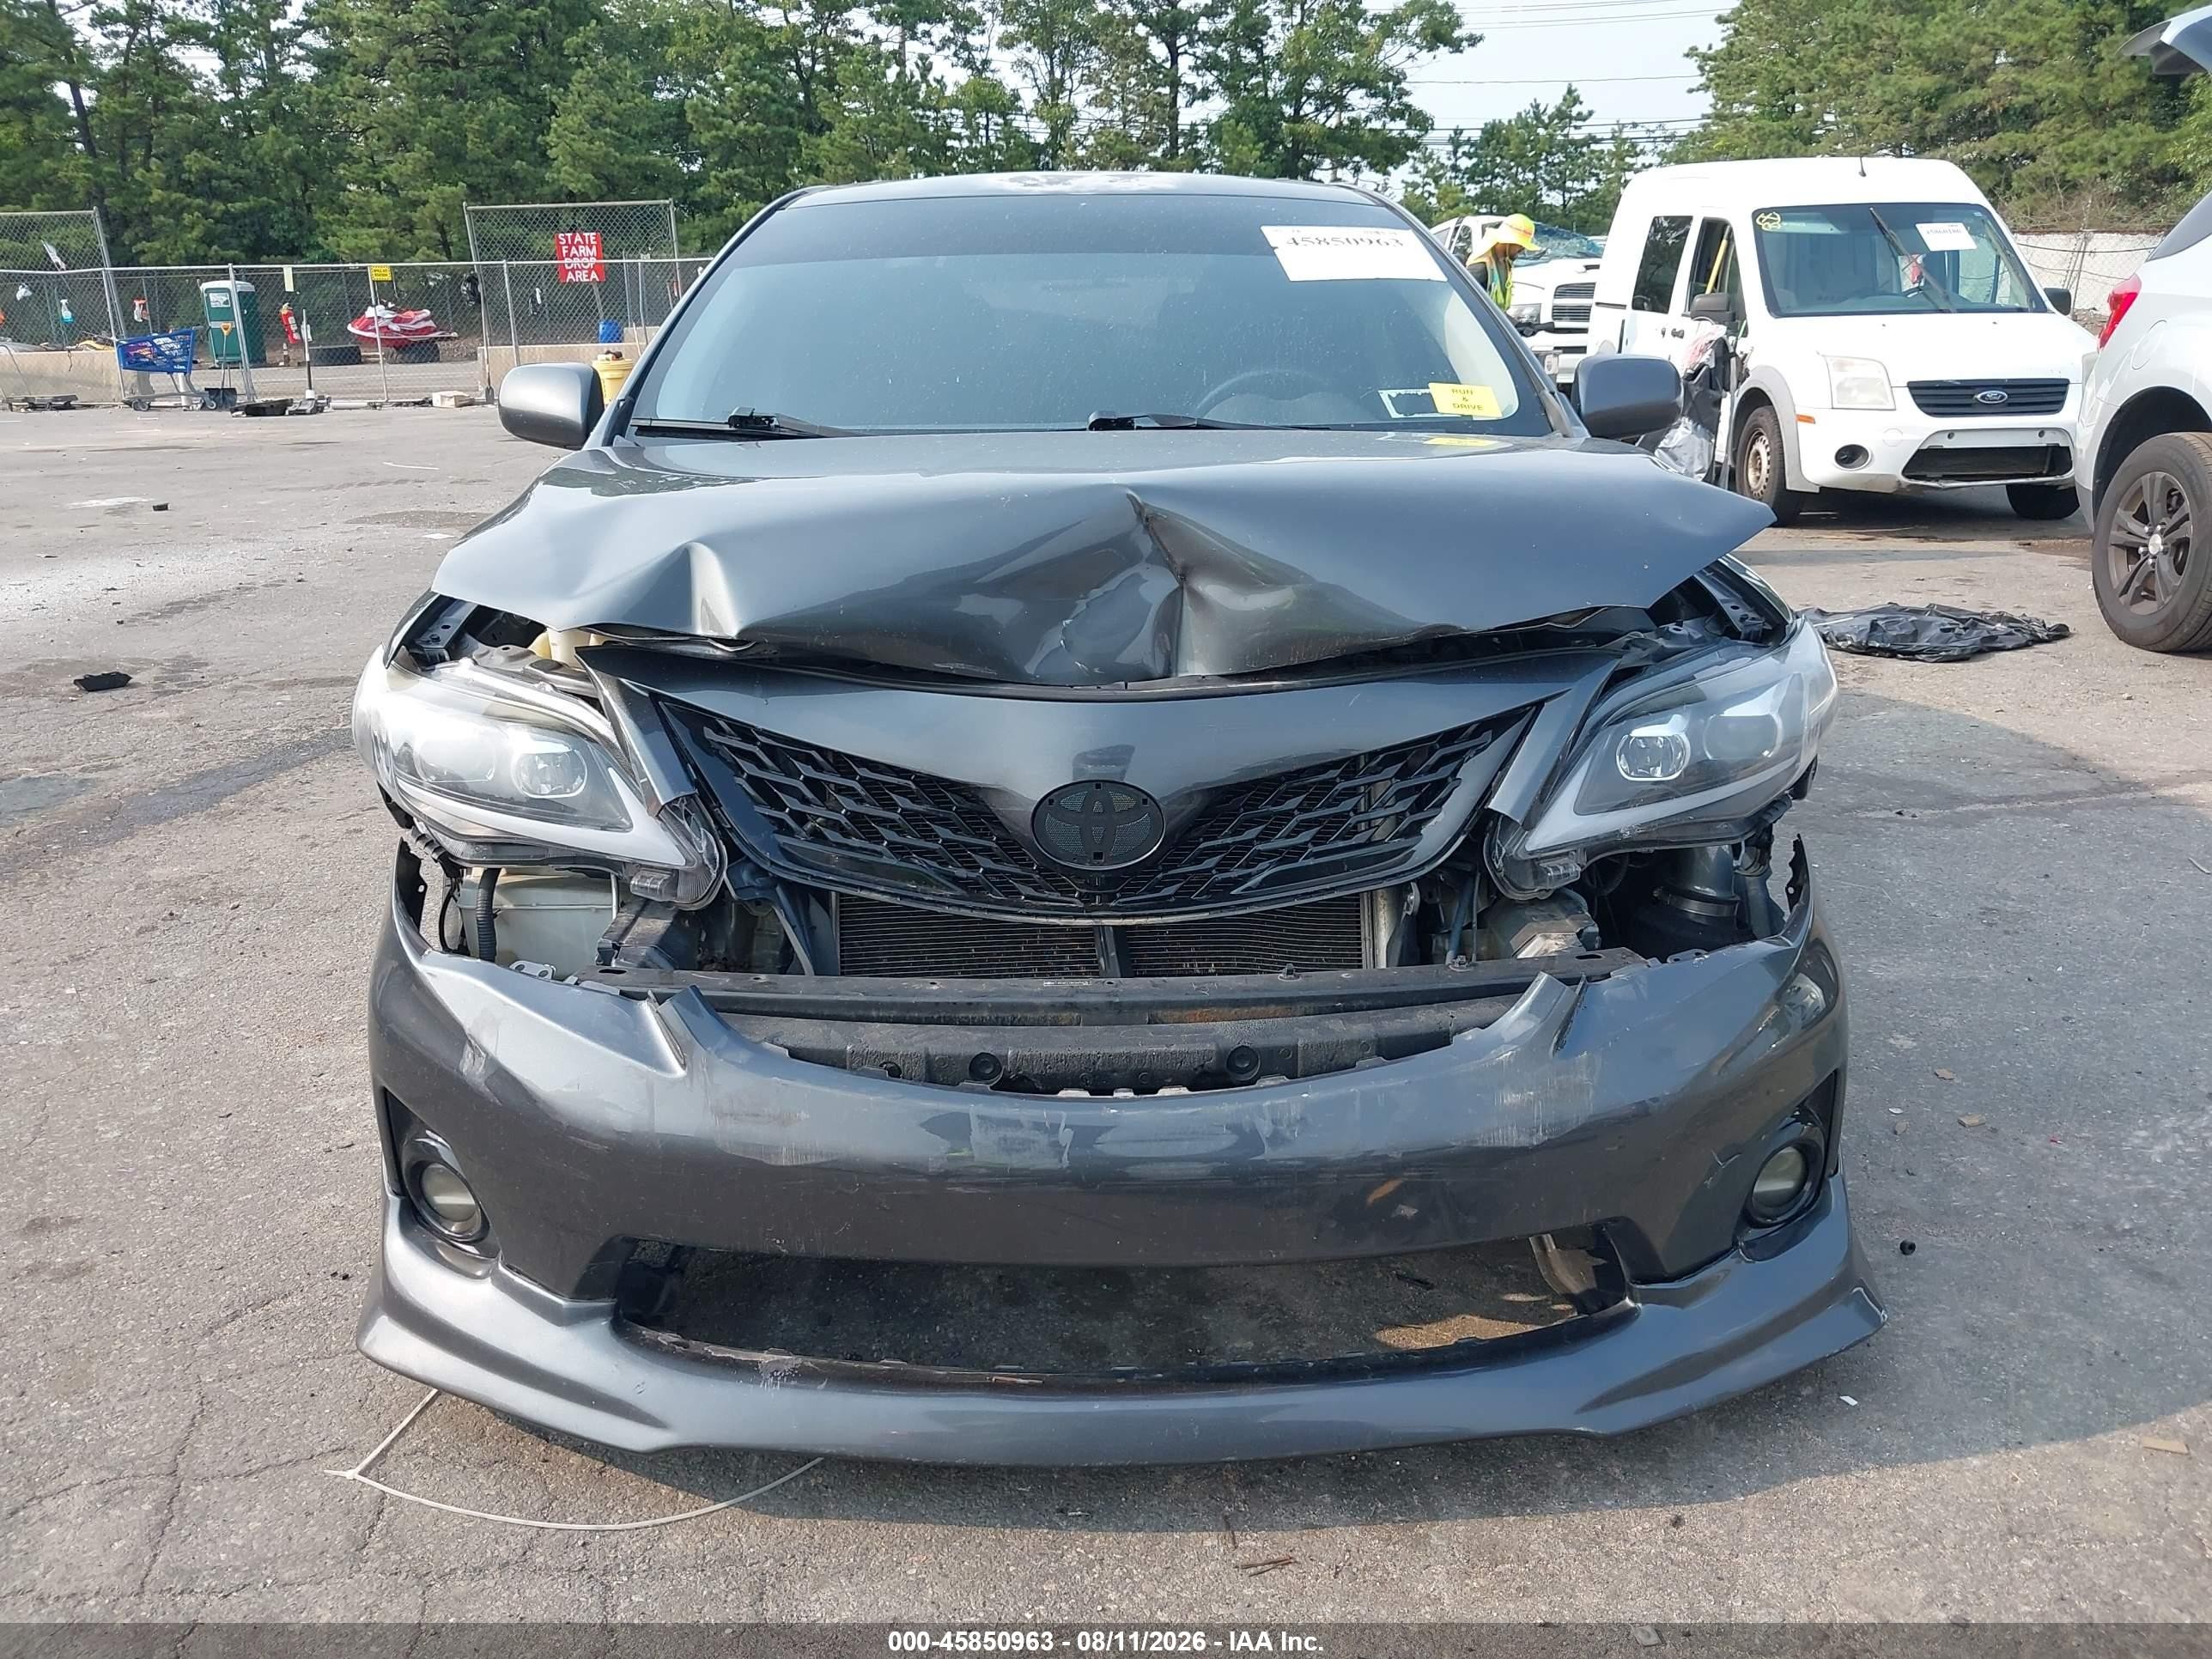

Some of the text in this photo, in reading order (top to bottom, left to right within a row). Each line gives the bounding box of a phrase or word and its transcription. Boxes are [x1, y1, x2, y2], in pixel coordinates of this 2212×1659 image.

[558, 233, 598, 245] STATE
[1286, 237, 1404, 247] 45850963
[562, 246, 598, 258] FARM
[564, 258, 598, 270] DROP
[566, 270, 599, 283] AREA
